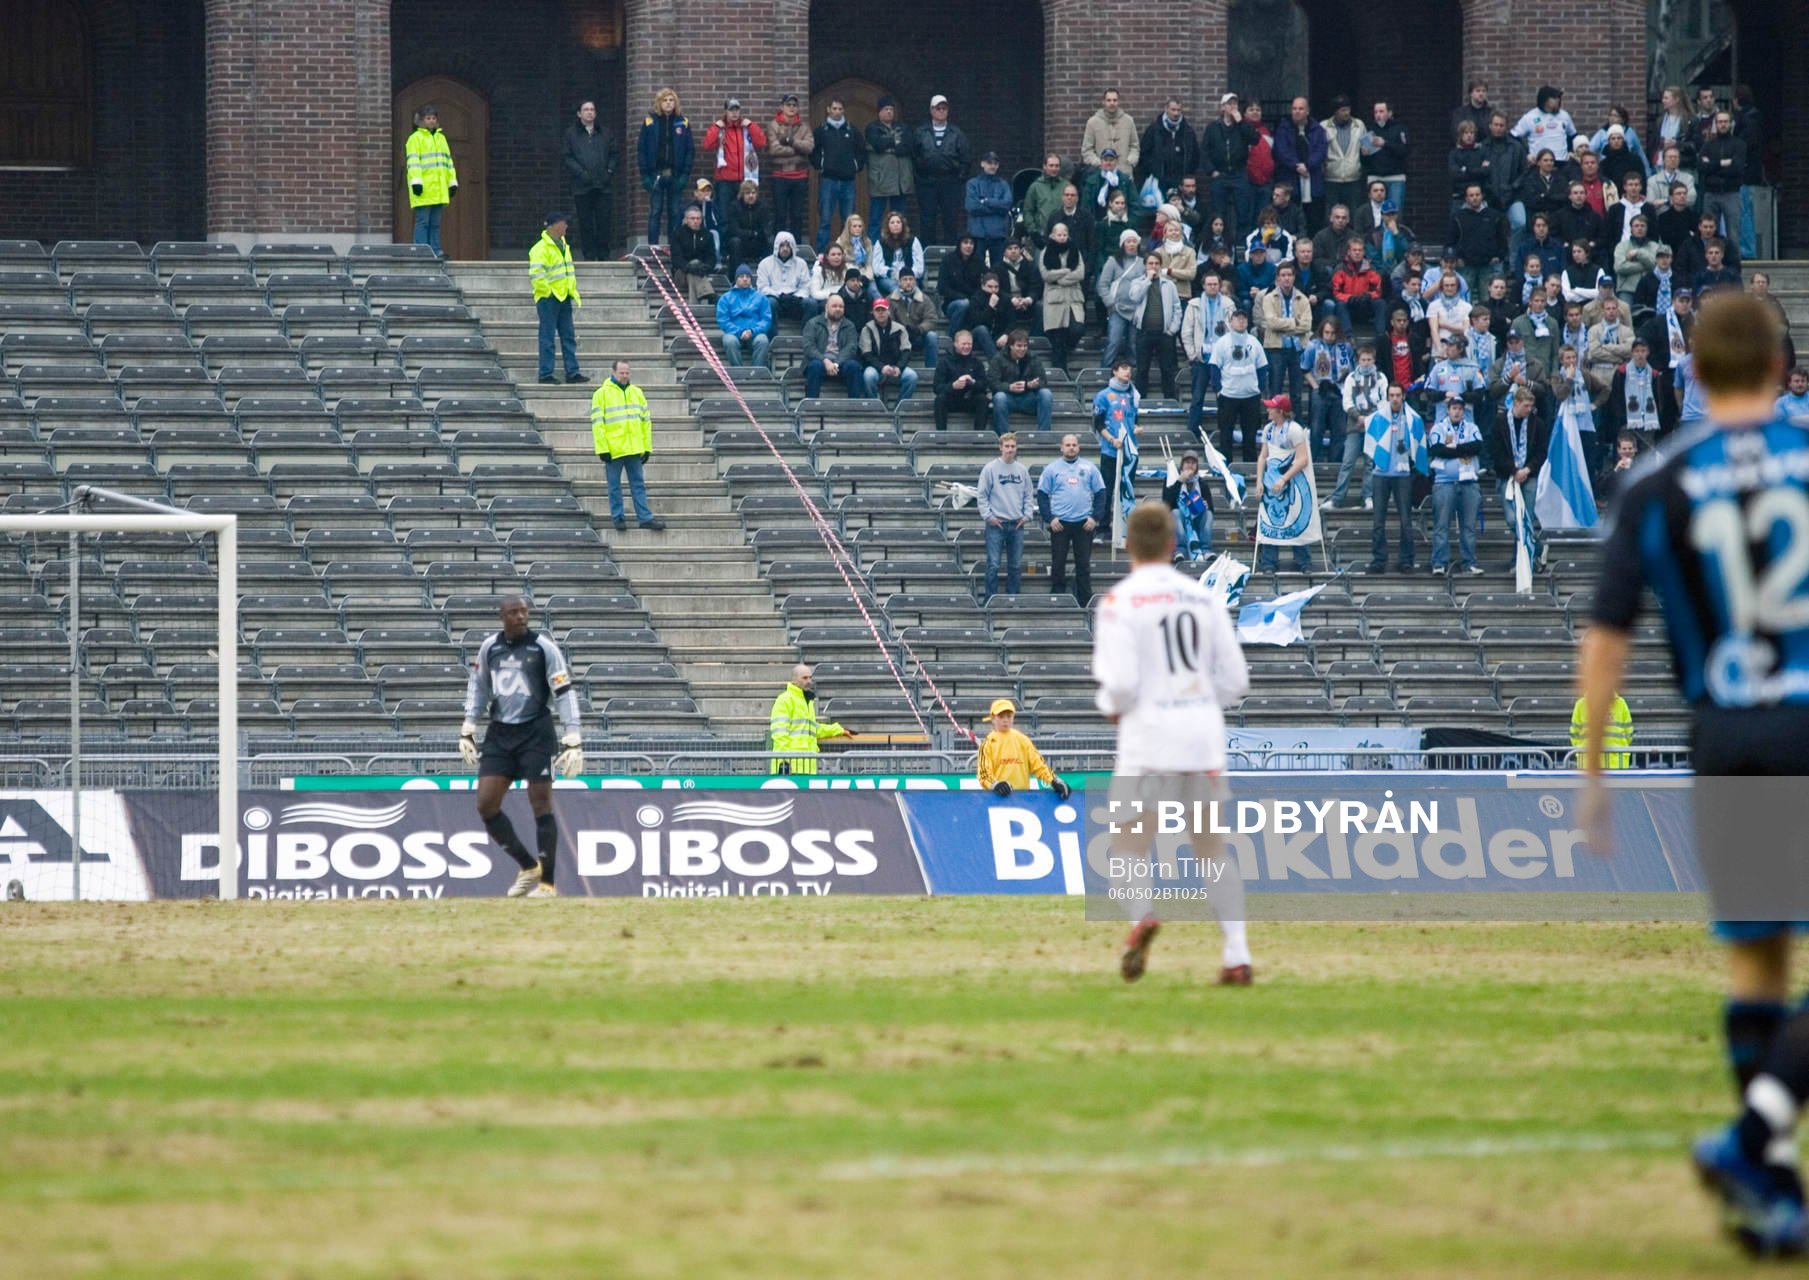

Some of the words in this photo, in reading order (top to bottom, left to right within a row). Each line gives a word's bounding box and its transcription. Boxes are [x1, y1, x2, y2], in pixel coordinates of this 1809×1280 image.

[1690, 488, 1809, 637] 12
[1158, 610, 1200, 675] 10
[490, 670, 531, 697] ICA
[407, 886, 444, 900] TV
[796, 882, 832, 897] TV
